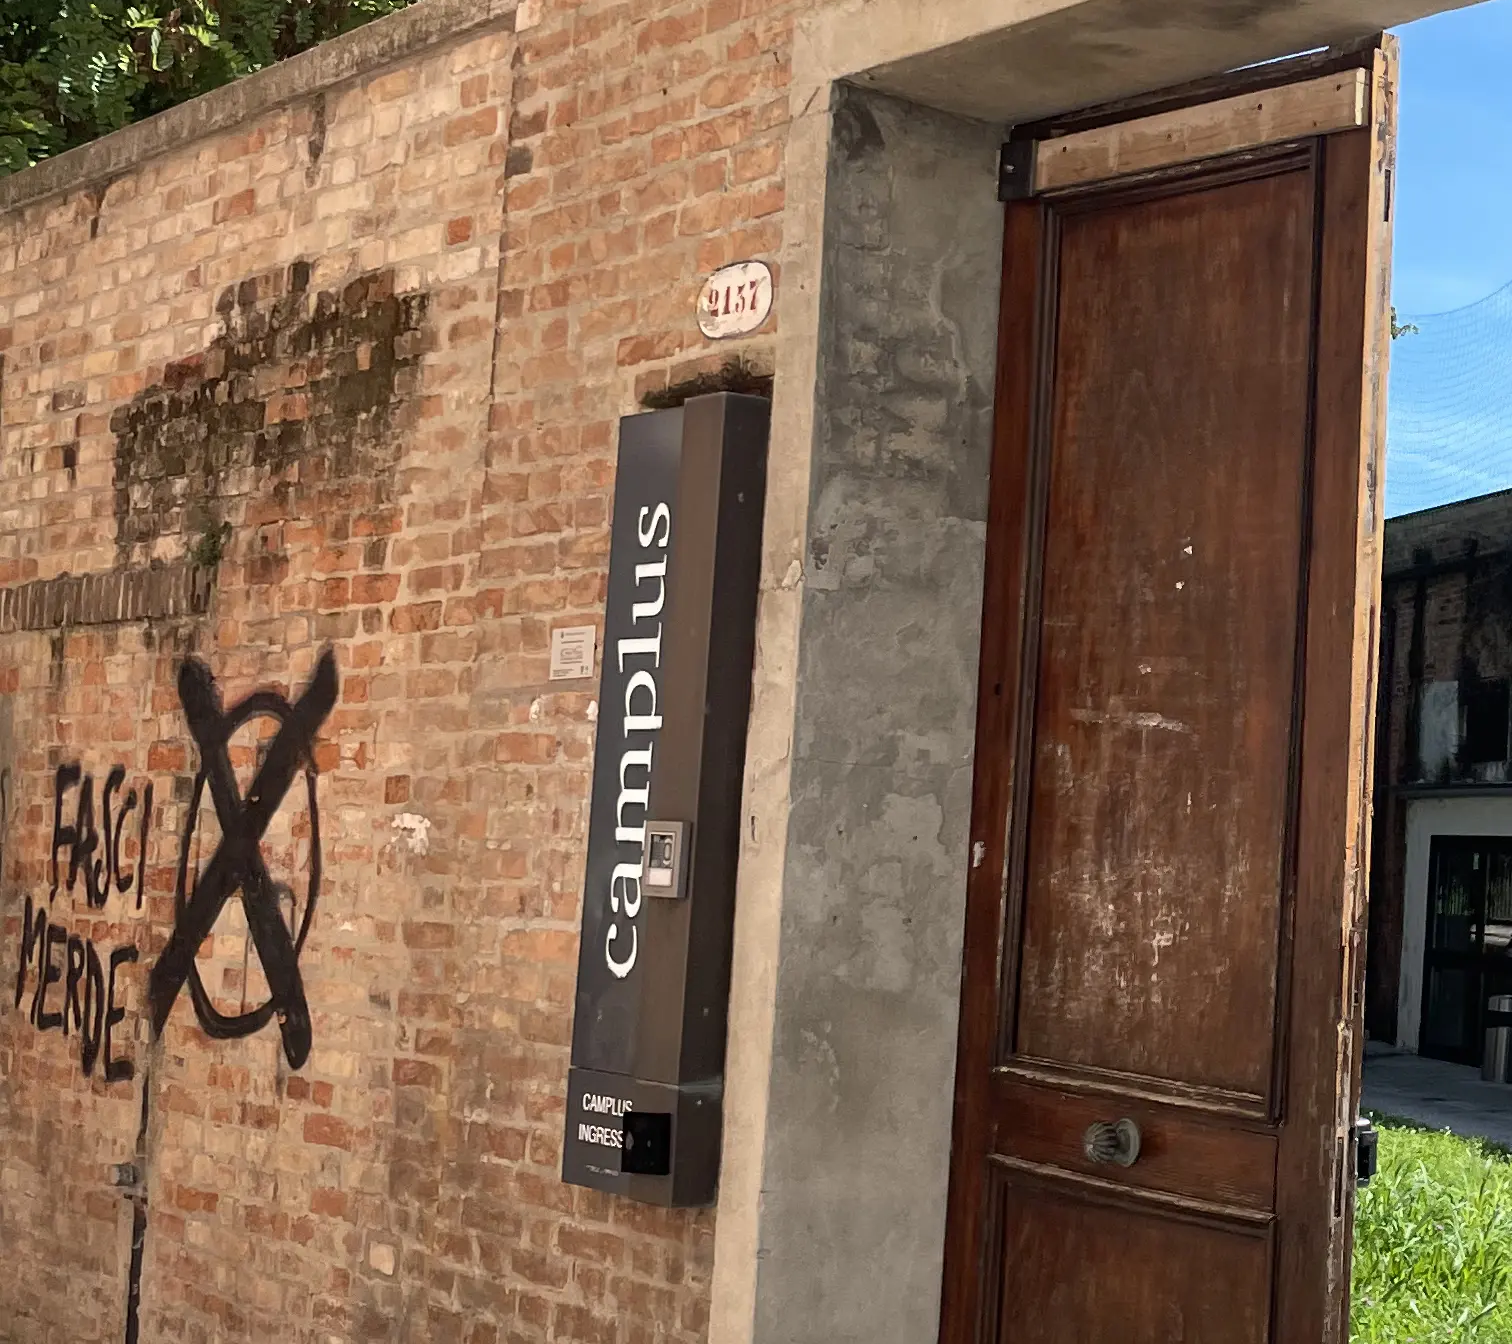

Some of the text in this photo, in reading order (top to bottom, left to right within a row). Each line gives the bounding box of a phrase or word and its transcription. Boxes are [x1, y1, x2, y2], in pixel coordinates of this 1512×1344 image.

[605, 501, 672, 980] camplus
[50, 763, 154, 909] FASCI
[15, 895, 139, 1082] MERDE
[578, 1123, 624, 1148] INGRESS
[582, 1092, 633, 1117] CAMPLUS
